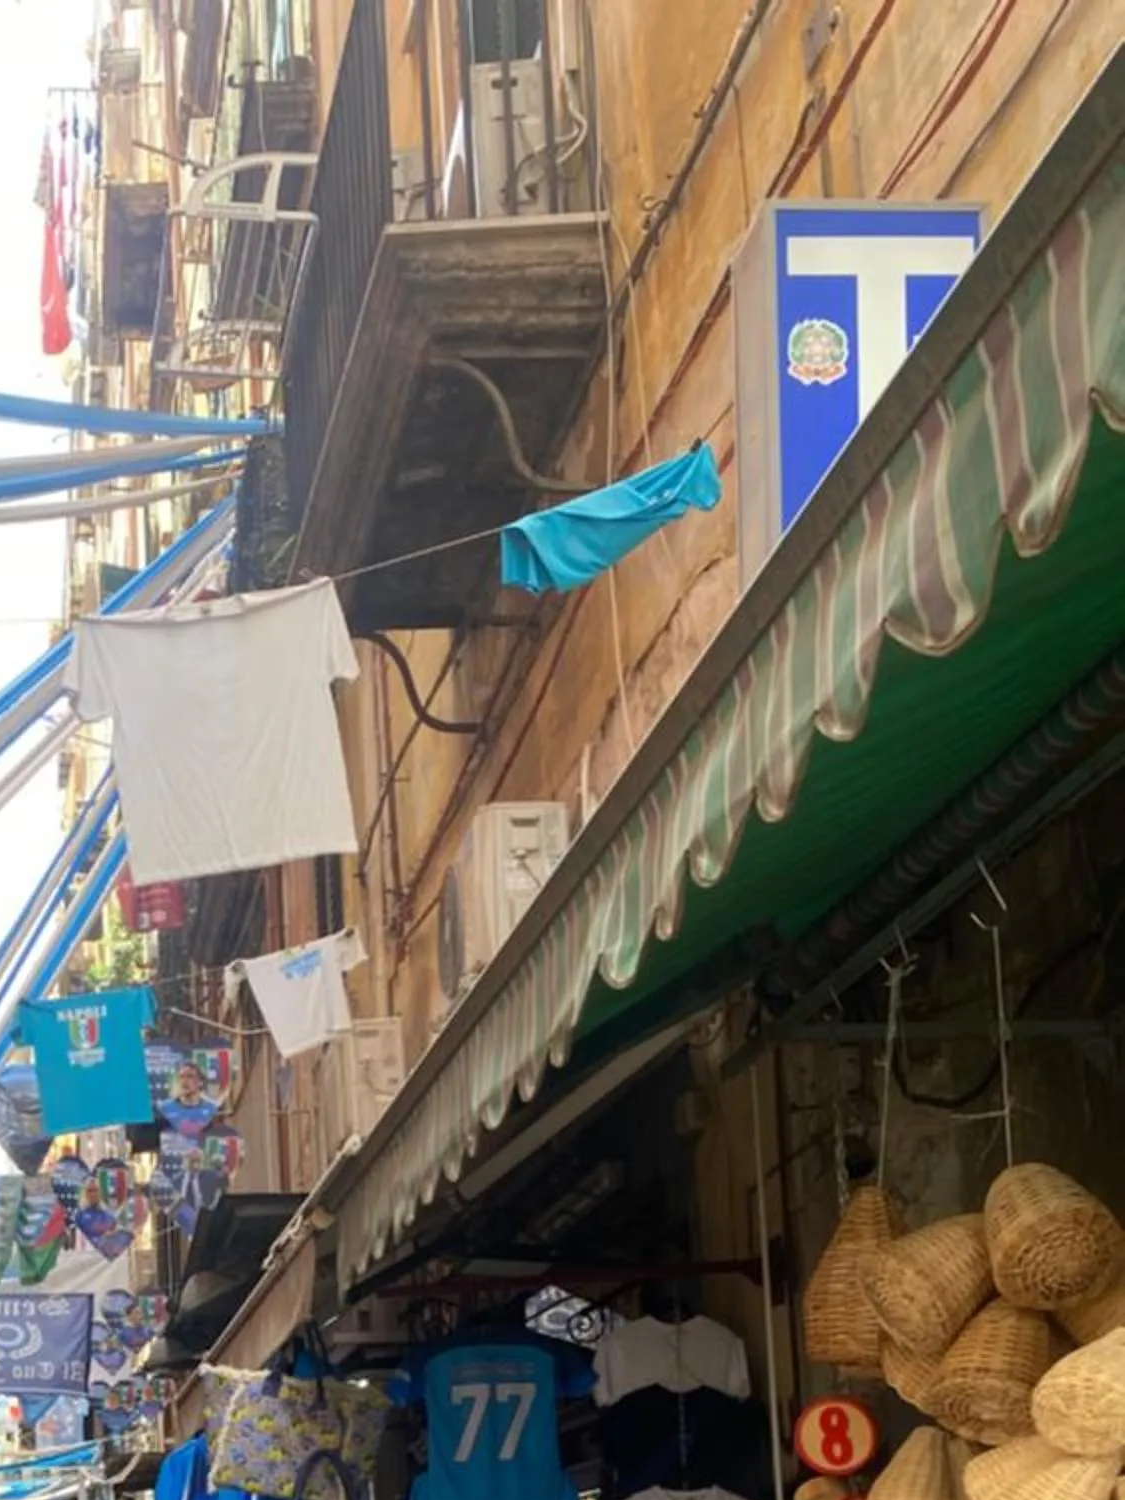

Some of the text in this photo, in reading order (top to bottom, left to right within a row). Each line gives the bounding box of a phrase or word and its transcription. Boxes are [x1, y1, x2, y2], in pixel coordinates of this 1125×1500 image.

[786, 235, 975, 424] T
[451, 1382, 537, 1462] 77
[819, 1406, 854, 1467] 8
